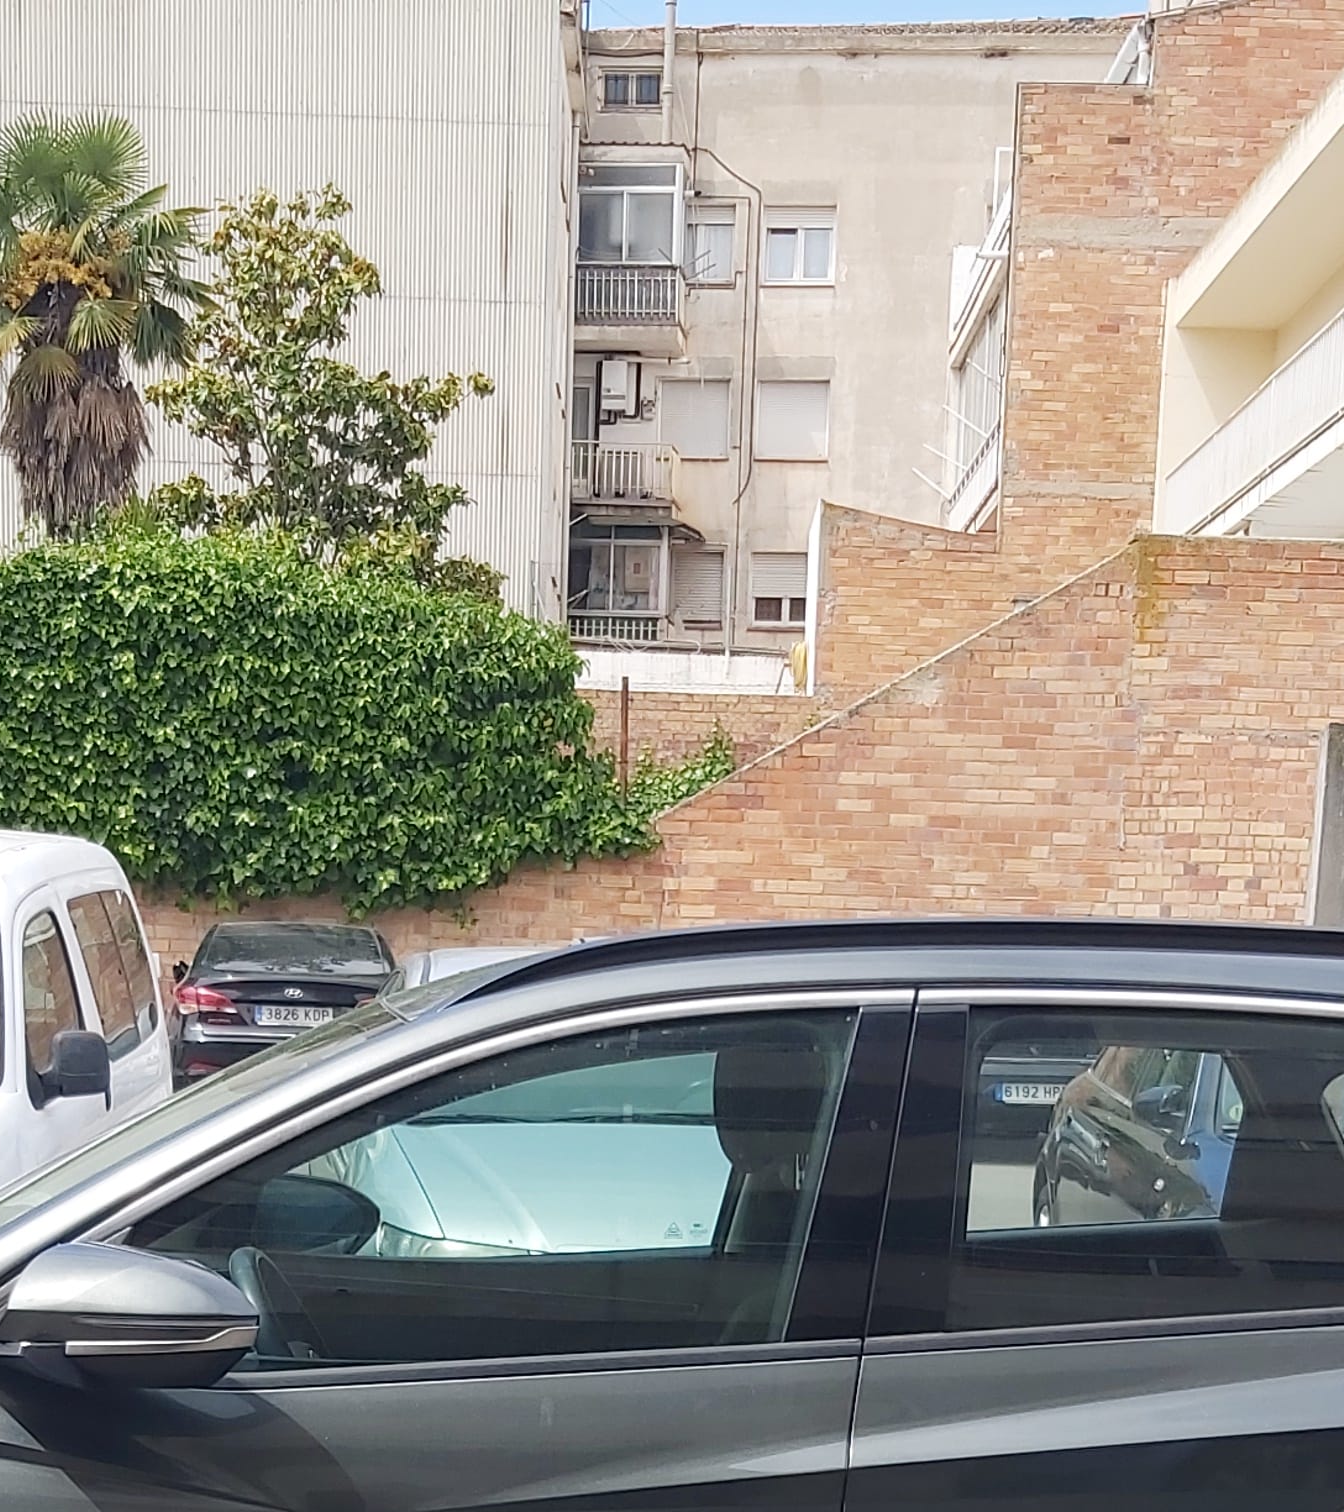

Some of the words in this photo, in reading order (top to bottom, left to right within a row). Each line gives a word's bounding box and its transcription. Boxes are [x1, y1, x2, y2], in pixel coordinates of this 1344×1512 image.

[265, 1008, 299, 1020] 3826
[1004, 1086, 1039, 1098] 6192
[1043, 1086, 1065, 1099] HP
